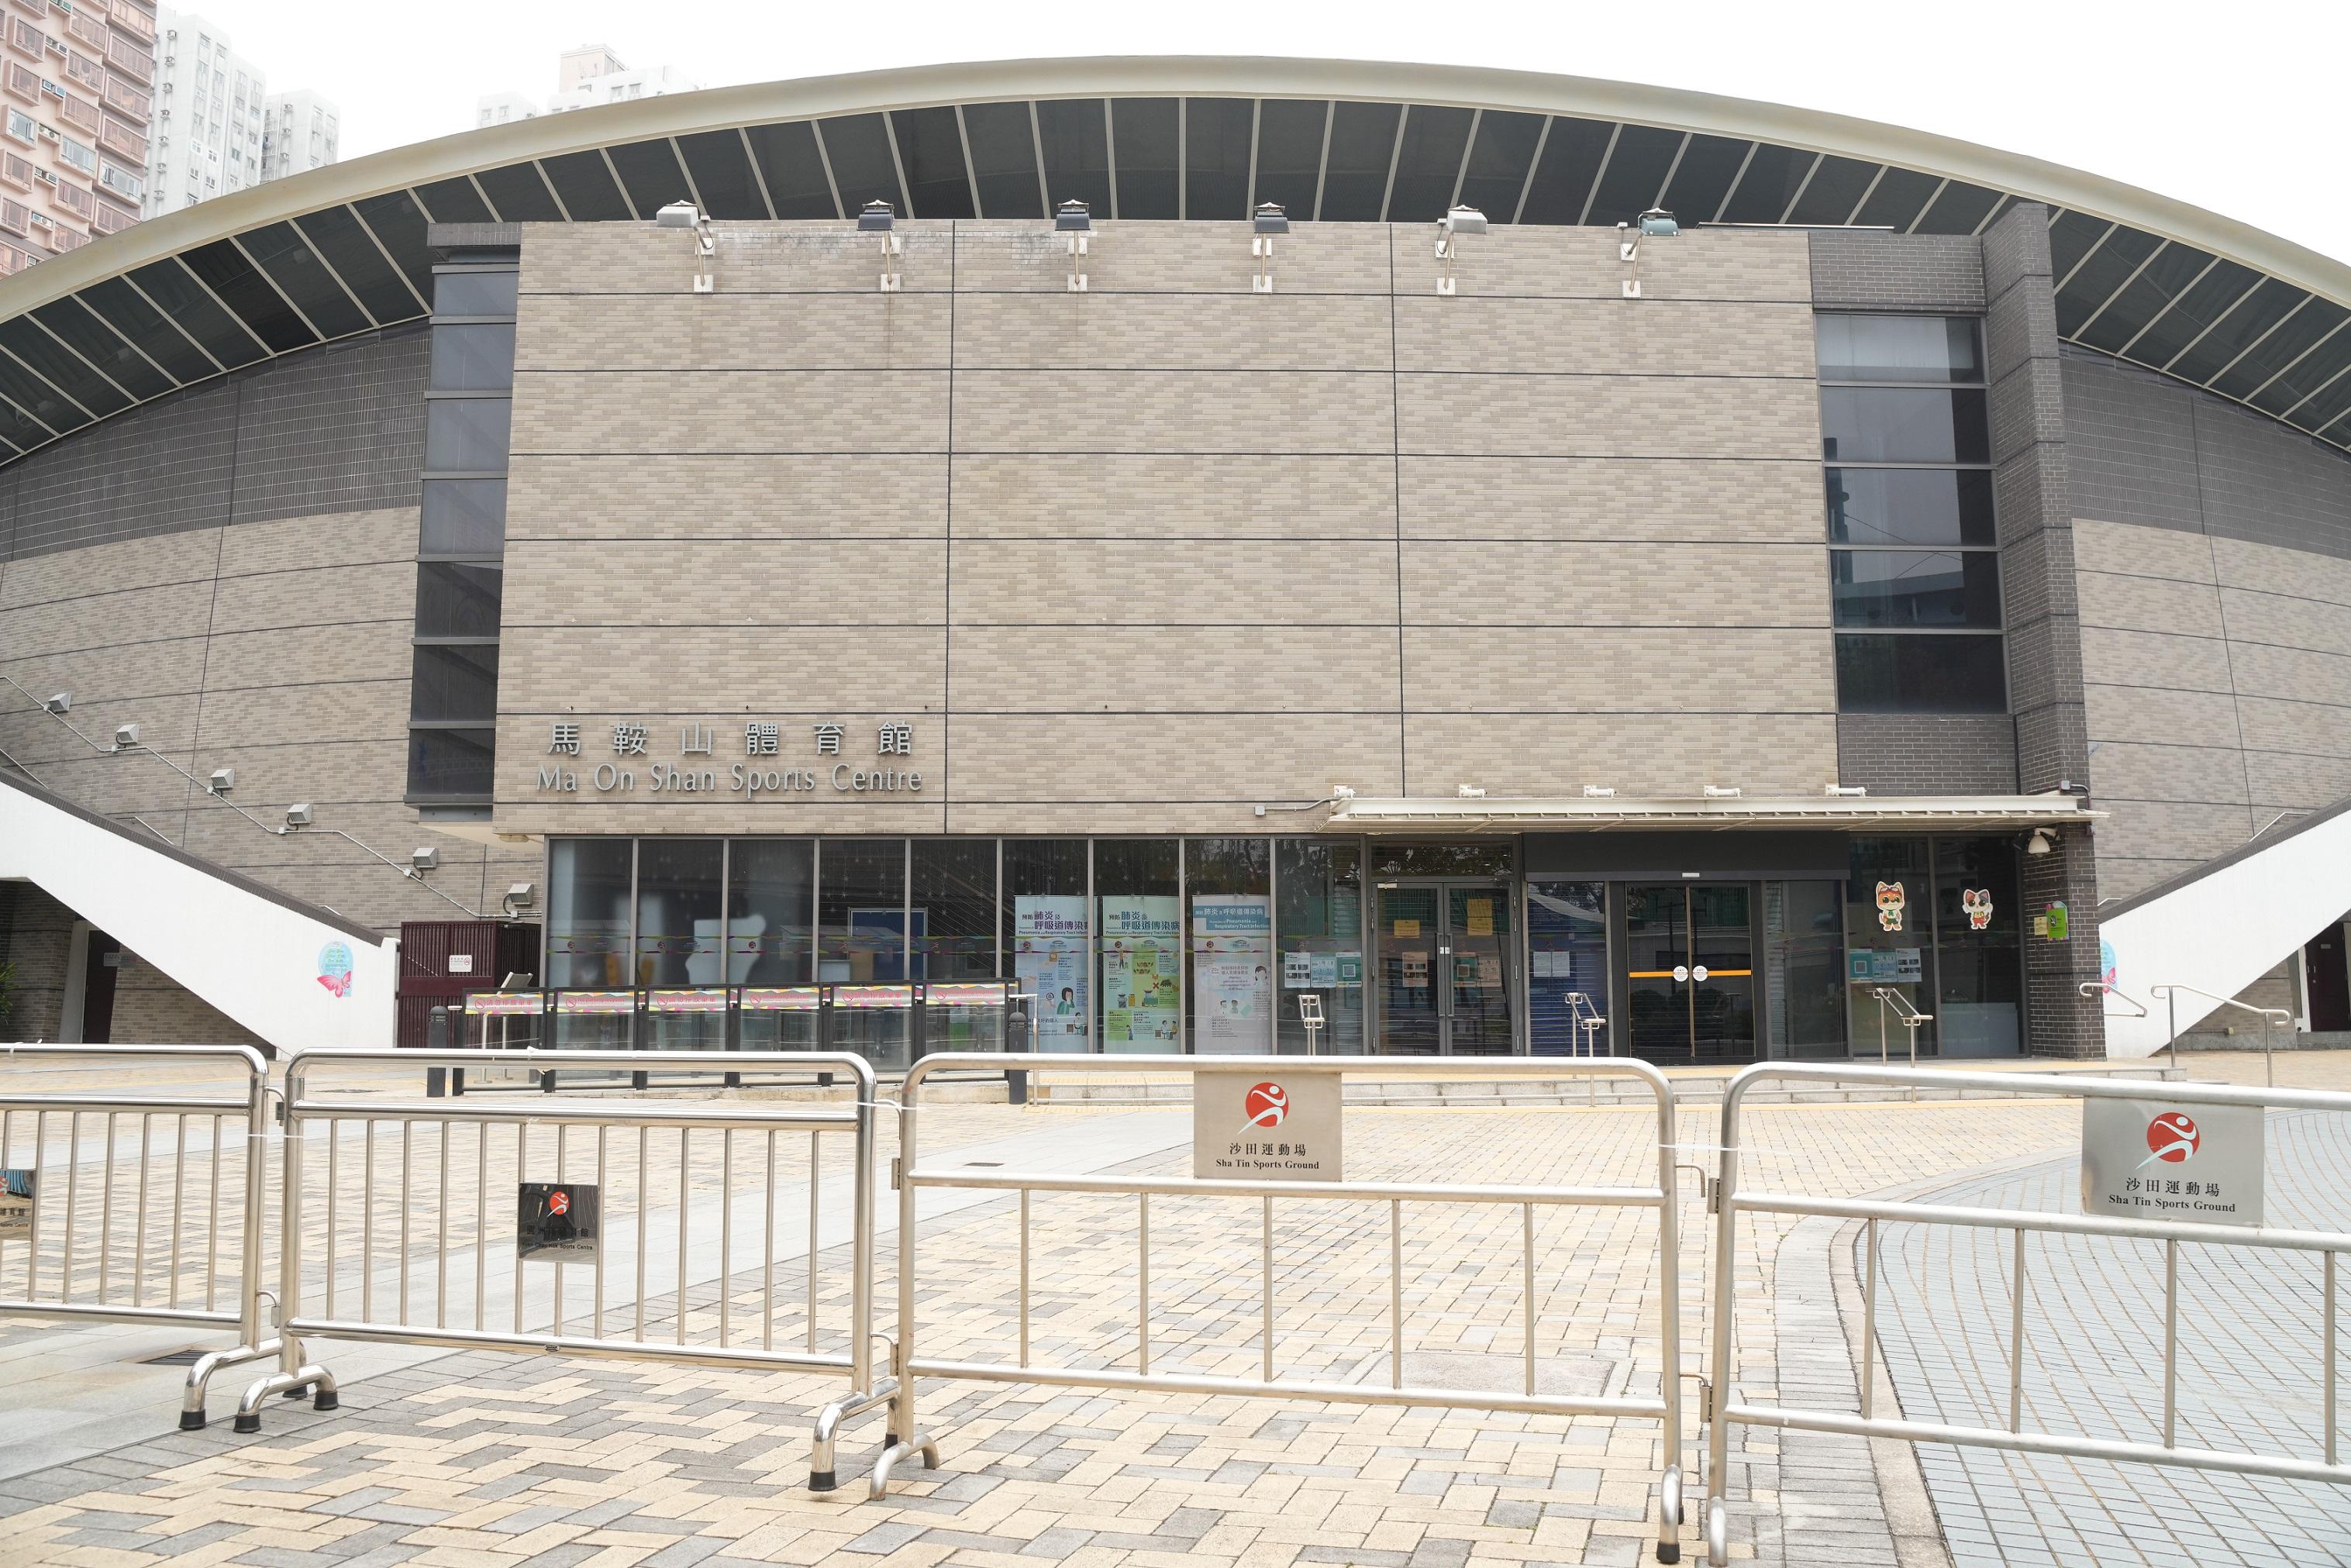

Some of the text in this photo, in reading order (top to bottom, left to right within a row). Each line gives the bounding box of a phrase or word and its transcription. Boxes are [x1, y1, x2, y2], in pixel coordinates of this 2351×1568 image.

[547, 721, 913, 756] 馬鞍山體育館
[536, 762, 922, 799] Ma On Shan Sports Centre
[1229, 1142, 1306, 1156] 沙田運動場
[1216, 1159, 1319, 1170] Sha Tin Sports Ground
[2125, 1177, 2220, 1198] 沙田運動場
[2108, 1194, 2236, 1212] Sha Tin Sports Ground
